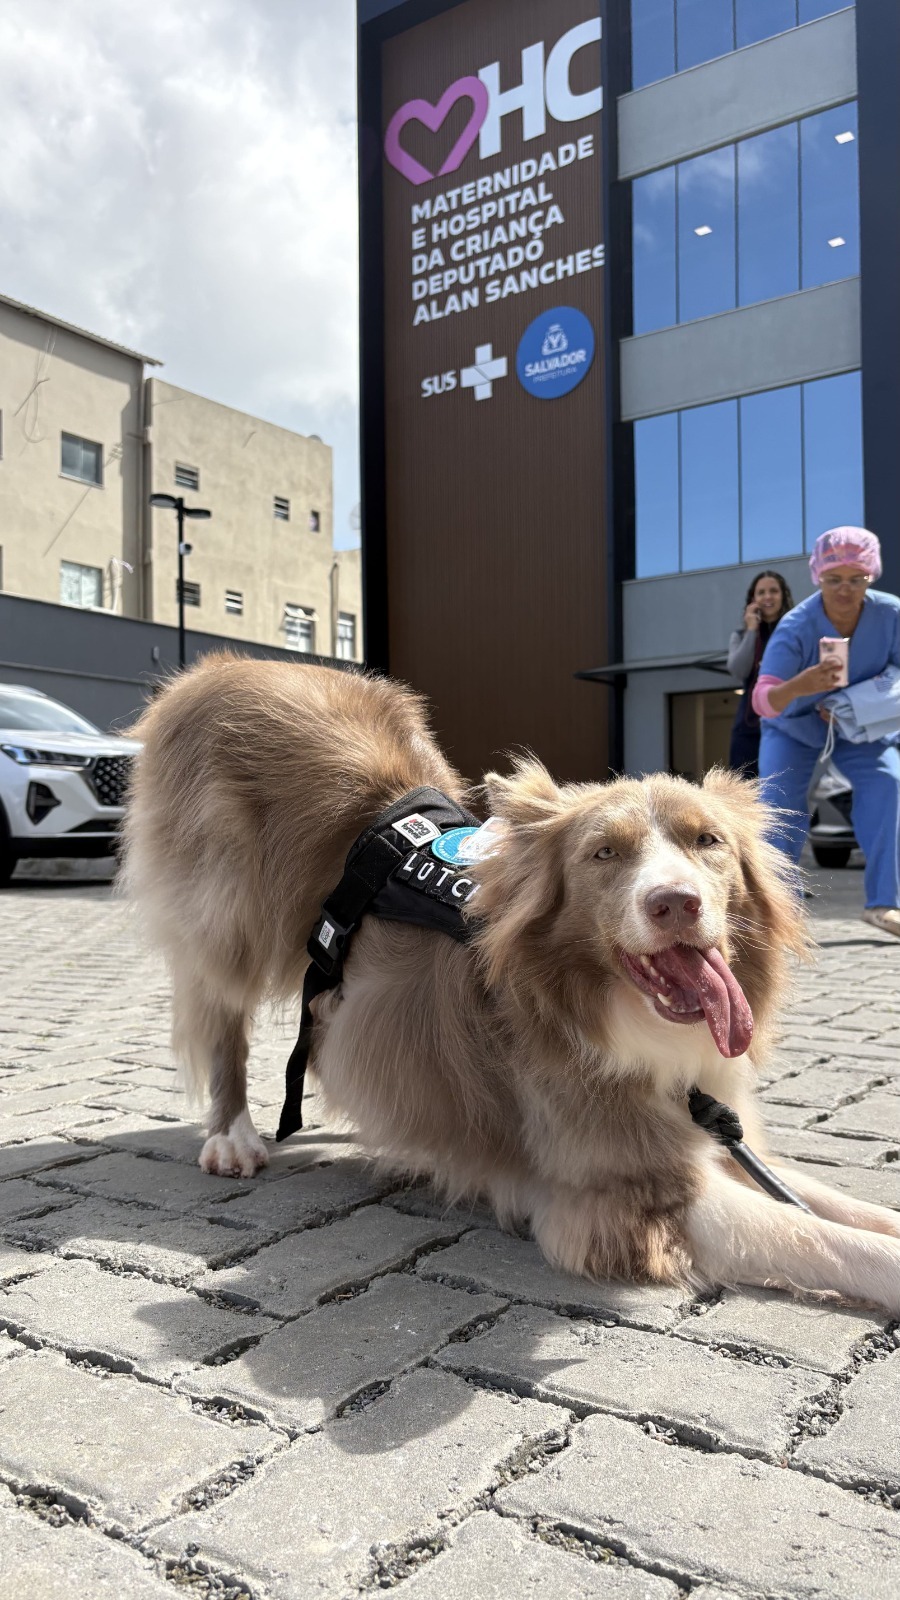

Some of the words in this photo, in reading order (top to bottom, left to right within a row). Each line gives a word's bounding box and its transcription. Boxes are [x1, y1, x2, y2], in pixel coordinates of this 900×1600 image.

[478, 17, 603, 160] HC
[412, 134, 594, 225] MATERNIDADE
[412, 225, 427, 250] E
[432, 182, 553, 243] HOSPITAL
[412, 245, 445, 276] DA
[450, 205, 565, 263] CRIANÇA
[412, 240, 544, 300] DEPUTADO
[413, 287, 479, 326] ALAN
[485, 244, 604, 302] SANCHES
[421, 370, 457, 398] SUS
[525, 349, 586, 377] SALVADOR
